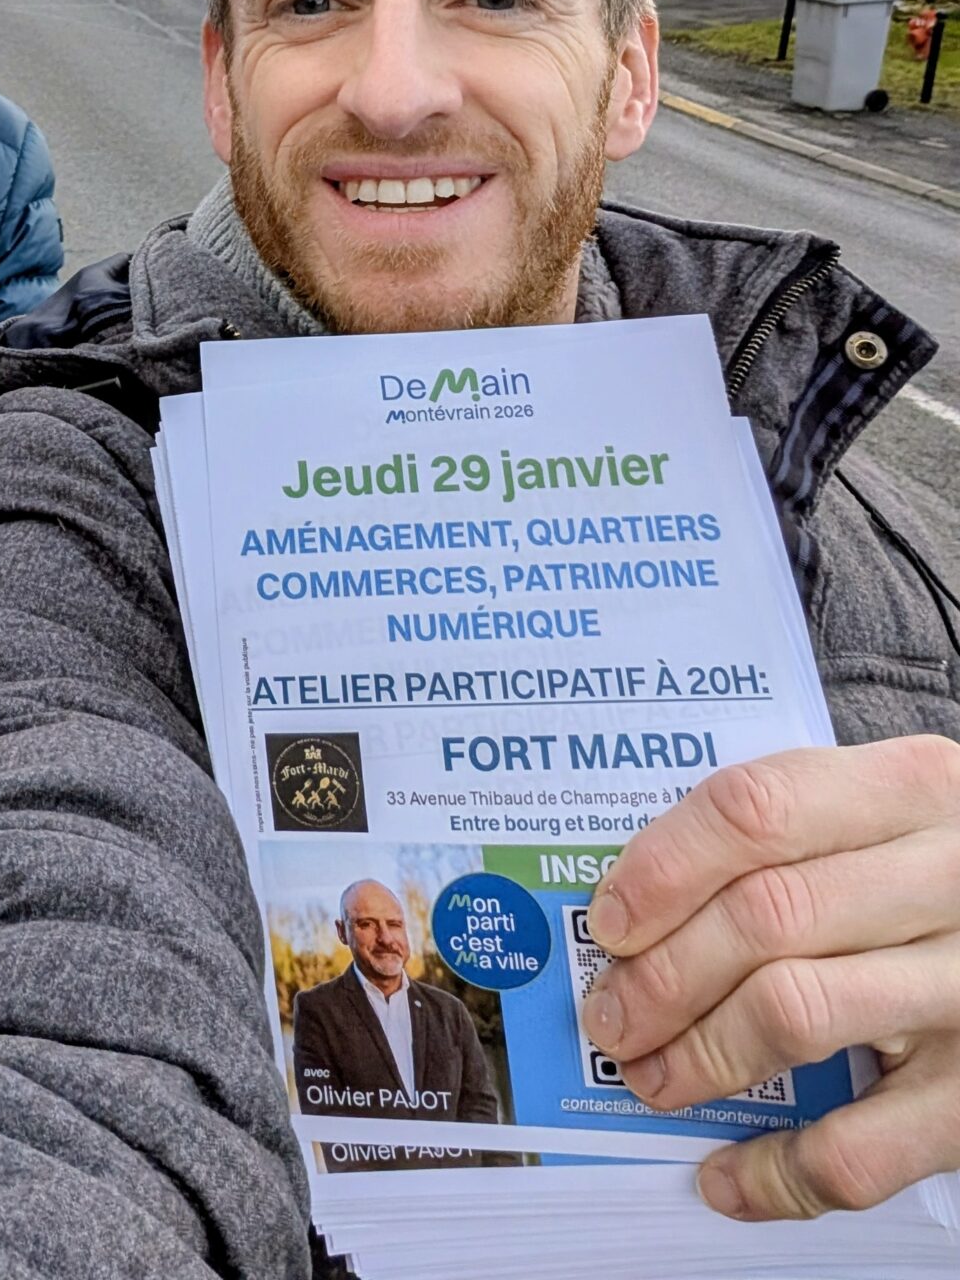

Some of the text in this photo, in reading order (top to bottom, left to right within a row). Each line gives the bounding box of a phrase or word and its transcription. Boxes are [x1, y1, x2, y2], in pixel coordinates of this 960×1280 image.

[380, 367, 531, 403] DeMain
[385, 404, 534, 424] Montévrain 2026
[281, 445, 670, 503] Jeudi 29 janvier
[240, 513, 721, 556] AMÉNAGEMENT, QUARTIERS
[256, 559, 720, 600] COMMERCES, PATRIMOINE
[387, 605, 602, 642] NUMÉRIQUE
[251, 659, 770, 706] ATELIER PARTICIPATIF À 20H:
[441, 731, 719, 772] FORT MARDI
[280, 762, 350, 781] Fort-Mardi
[386, 791, 407, 806] 33
[410, 791, 467, 806] Avenue
[469, 790, 534, 806] Thibaud
[537, 790, 558, 805] de
[560, 789, 658, 808] Champagne
[662, 787, 672, 803] à
[450, 813, 657, 836] Entre bourg et Bord d
[448, 893, 501, 913] Mon
[466, 913, 515, 934] parti
[450, 933, 504, 952] c'est
[455, 951, 539, 971] Ma ville
[304, 1068, 330, 1078] avec
[307, 1084, 452, 1111] Olivier PAJOT
[331, 1142, 401, 1162] Olivier
